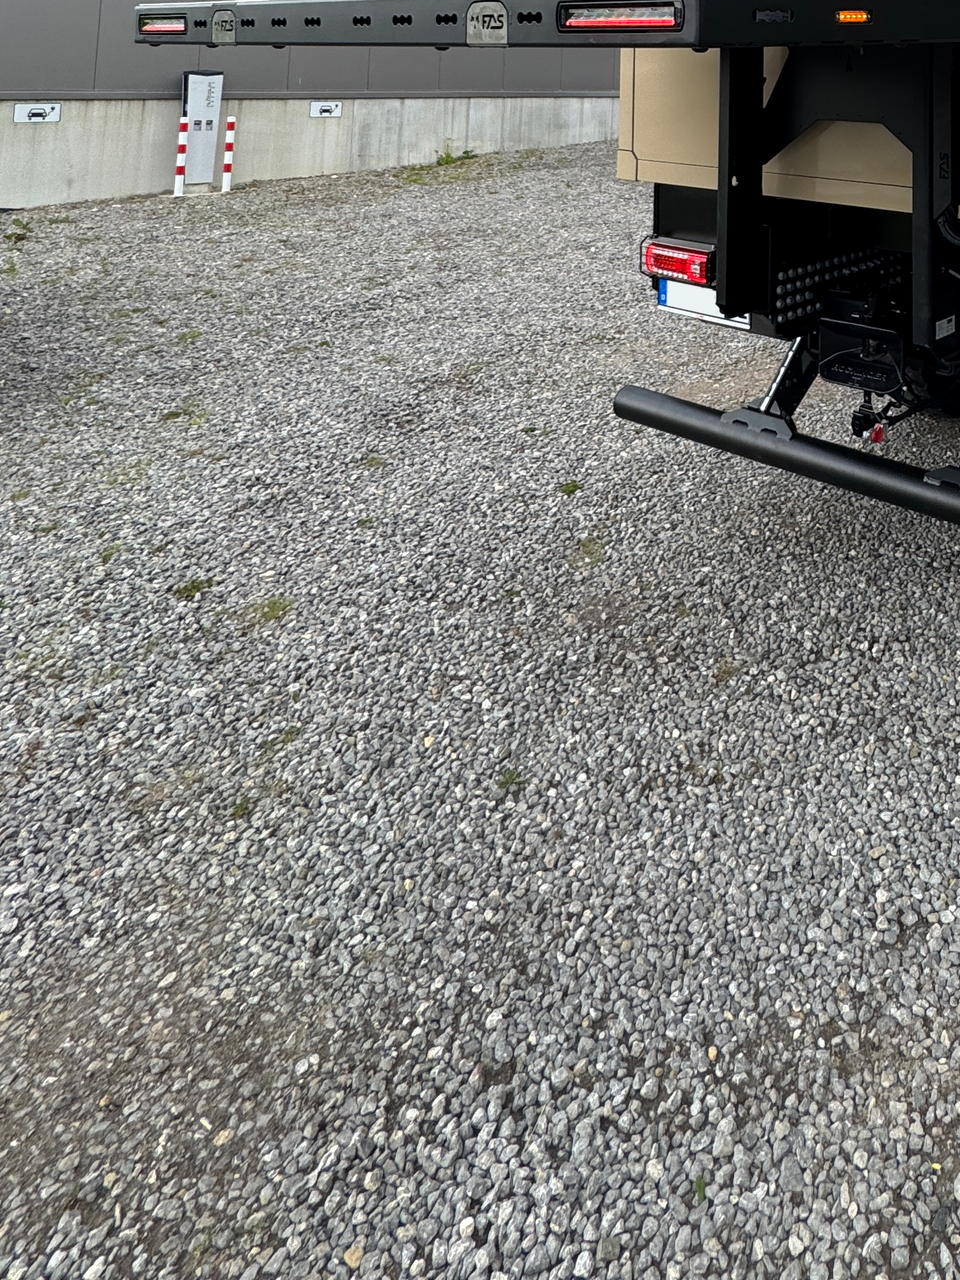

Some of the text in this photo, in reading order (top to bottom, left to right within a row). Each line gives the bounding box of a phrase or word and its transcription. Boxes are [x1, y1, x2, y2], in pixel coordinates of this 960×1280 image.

[220, 20, 234, 32] FAS
[482, 13, 504, 30] FAS
[939, 152, 949, 180] FAS
